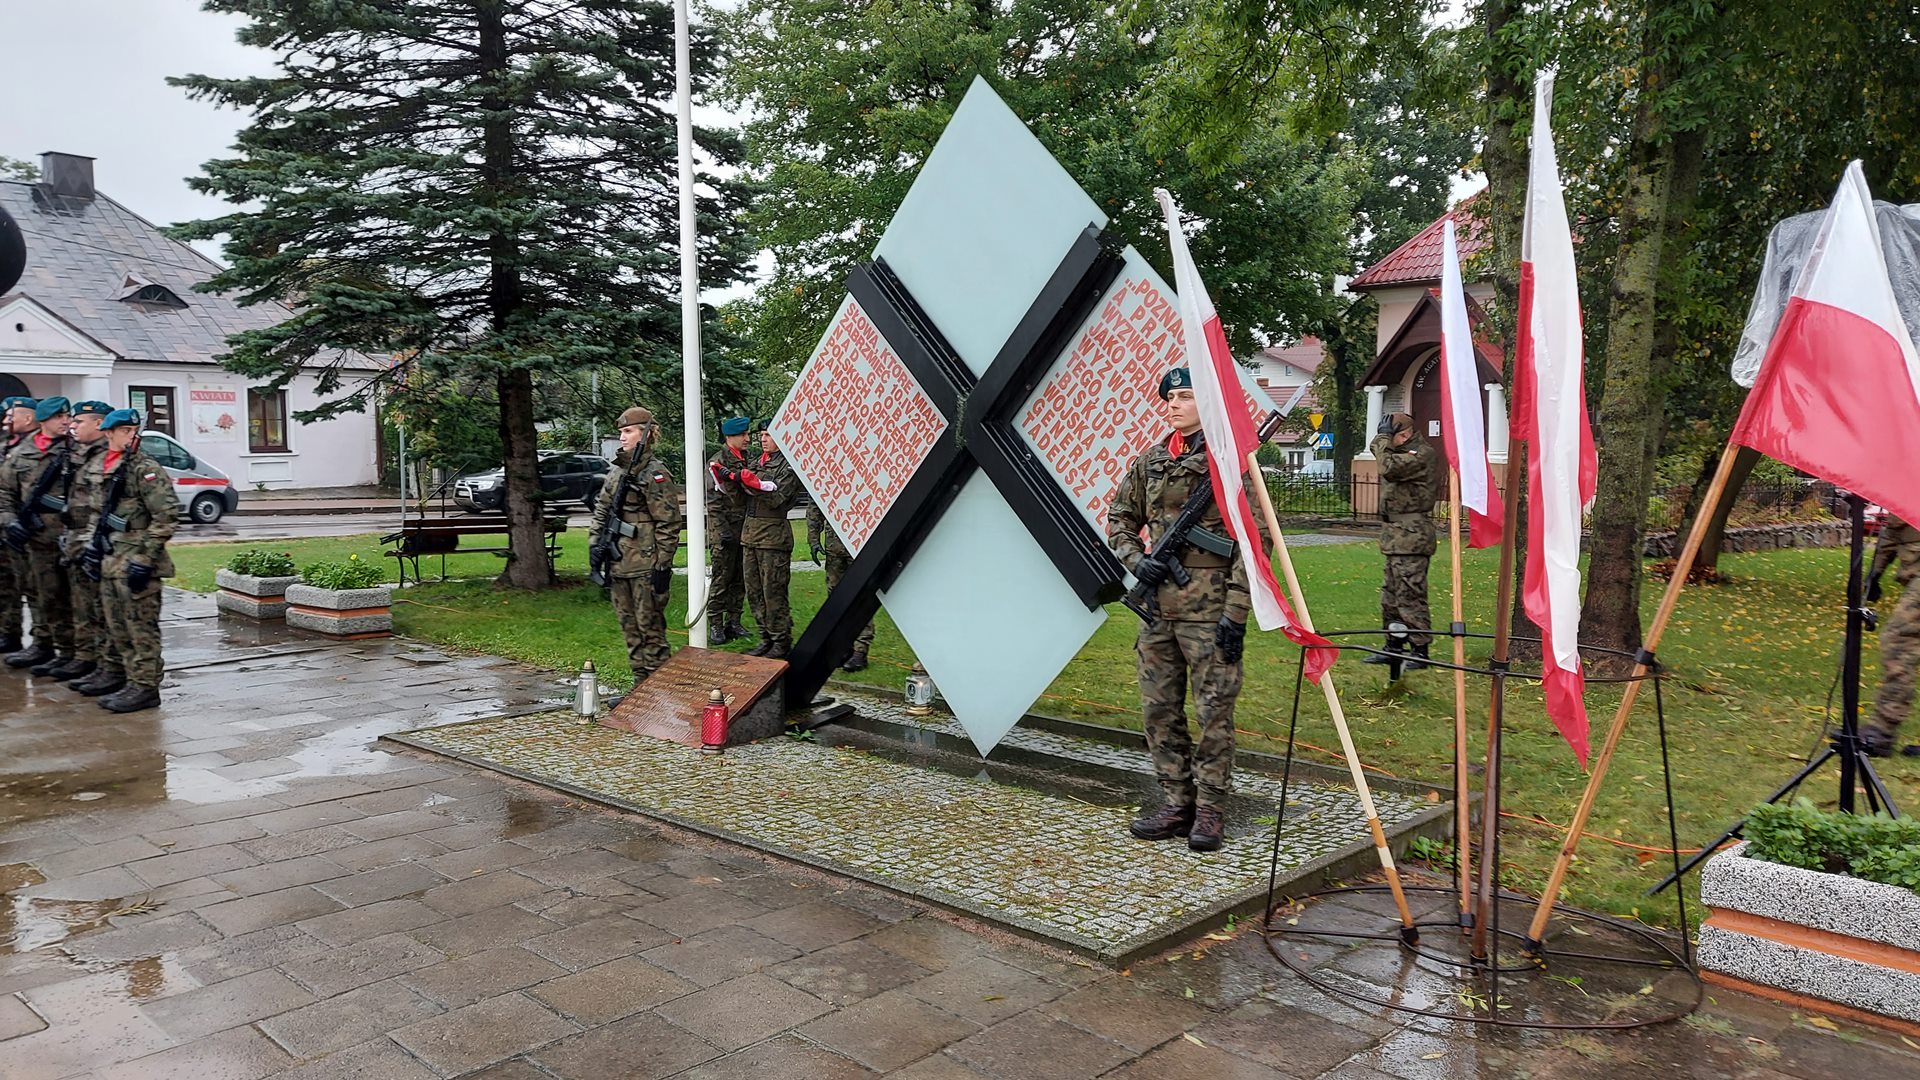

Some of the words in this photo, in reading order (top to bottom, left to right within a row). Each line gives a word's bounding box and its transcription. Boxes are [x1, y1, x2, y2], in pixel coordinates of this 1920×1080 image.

[833, 326, 859, 362] NAD
[866, 372, 928, 456] GROBAMI
[840, 314, 890, 384] ZABRZMIEĆ
[890, 383, 936, 444] 10.IV.2010
[847, 302, 880, 351] SŁOWA,
[880, 349, 913, 394] KTÓRE
[912, 392, 944, 434] MIAŁY
[1077, 334, 1172, 446] WYZWOLEN
[1088, 320, 1126, 366] JAKO
[1112, 285, 1127, 305] A
[1129, 304, 1189, 368] PRAW
[191, 392, 235, 400] KWIATY
[794, 389, 883, 520] WYZWALAJĄC
[800, 379, 839, 436] NASZYCH
[837, 433, 890, 509] SUMIENIACH
[806, 368, 847, 430] BRZMIĄ
[885, 482, 897, 499] W
[813, 358, 824, 374] W
[827, 378, 869, 442] KATYNIU,
[873, 444, 905, 489] NIECH
[819, 347, 912, 479] ZAMORDOWANYCH
[827, 336, 870, 399] POLSKICH
[872, 400, 920, 467] OFICERÓW
[1021, 411, 1088, 498] TADEUSZ
[1030, 397, 1100, 486] GENERAŁ
[1102, 486, 1117, 507] B
[1042, 381, 1096, 451] WOJSKA
[1094, 446, 1124, 488] POL
[1066, 351, 1102, 402] TEGO,
[1102, 395, 1127, 427] CO
[1122, 421, 1152, 455] ZNI
[1115, 441, 1138, 472] PO
[775, 421, 780, 429] I
[782, 429, 862, 551] NIESZCZĘŚCIA
[781, 411, 792, 425] W
[795, 430, 841, 500] OBLICZU
[845, 506, 868, 540] ZŁA
[787, 400, 801, 421] OD
[801, 419, 852, 496] WSZELKIEGO
[850, 493, 875, 531] LĘKU
